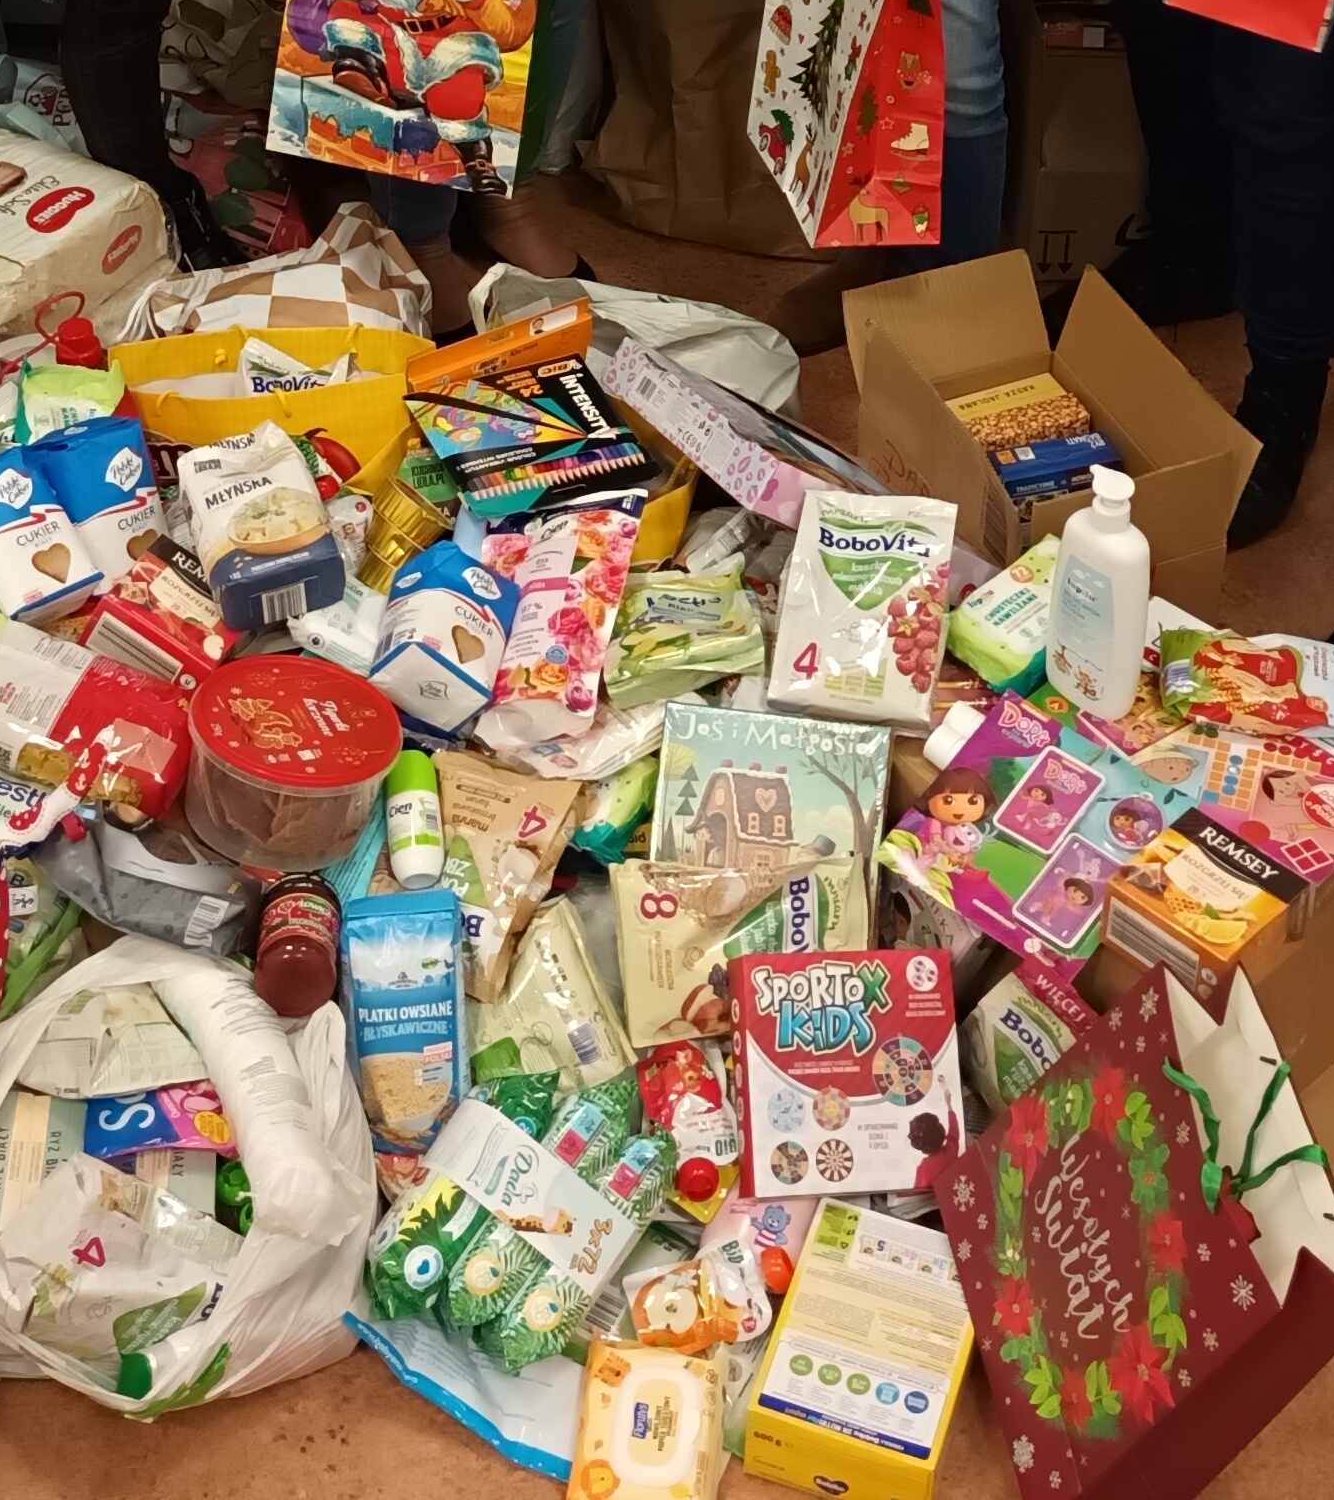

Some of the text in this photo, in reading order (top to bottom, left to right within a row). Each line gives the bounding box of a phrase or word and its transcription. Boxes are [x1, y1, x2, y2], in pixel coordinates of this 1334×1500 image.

[33, 189, 87, 225] HUGGIES
[542, 362, 567, 377] BIC
[520, 384, 544, 397] 24
[110, 457, 134, 479] Polski
[118, 467, 143, 486] Cukier
[411, 463, 444, 481] KUCHNIA
[7, 485, 30, 505] Cukier
[204, 476, 273, 510] MŁYNSKA
[15, 521, 62, 547] CUKIER
[118, 505, 157, 531] CUKIER
[540, 519, 569, 540] Cien
[171, 550, 210, 582] REM
[985, 586, 1031, 622] CHUSTECZKI
[1066, 576, 1098, 603] lupilu
[454, 604, 494, 639] CUKIER
[992, 592, 1039, 628] NAWILŻANE
[792, 642, 819, 680] 4
[676, 711, 875, 758] Jaś i Małgosia
[998, 700, 1052, 749] DORA
[1043, 757, 1089, 795] DORA
[388, 801, 414, 818] Cien
[451, 813, 490, 833] manna
[518, 805, 548, 839] 4
[1199, 825, 1279, 880] REMSEY
[1181, 852, 1232, 891] ROZGRZEJ
[640, 892, 679, 920] 8
[789, 875, 811, 952] Bobo
[358, 1000, 453, 1023] PŁATKI OWSIANE
[1036, 974, 1087, 1023] WIĘCEJ
[363, 1019, 450, 1043] BŁYSKAWICZNE
[999, 1007, 1054, 1071] Bobo
[170, 1150, 186, 1178] IAŁY
[500, 1150, 535, 1207] Dada
[71, 1235, 107, 1269] 4
[753, 1431, 774, 1443] 600
